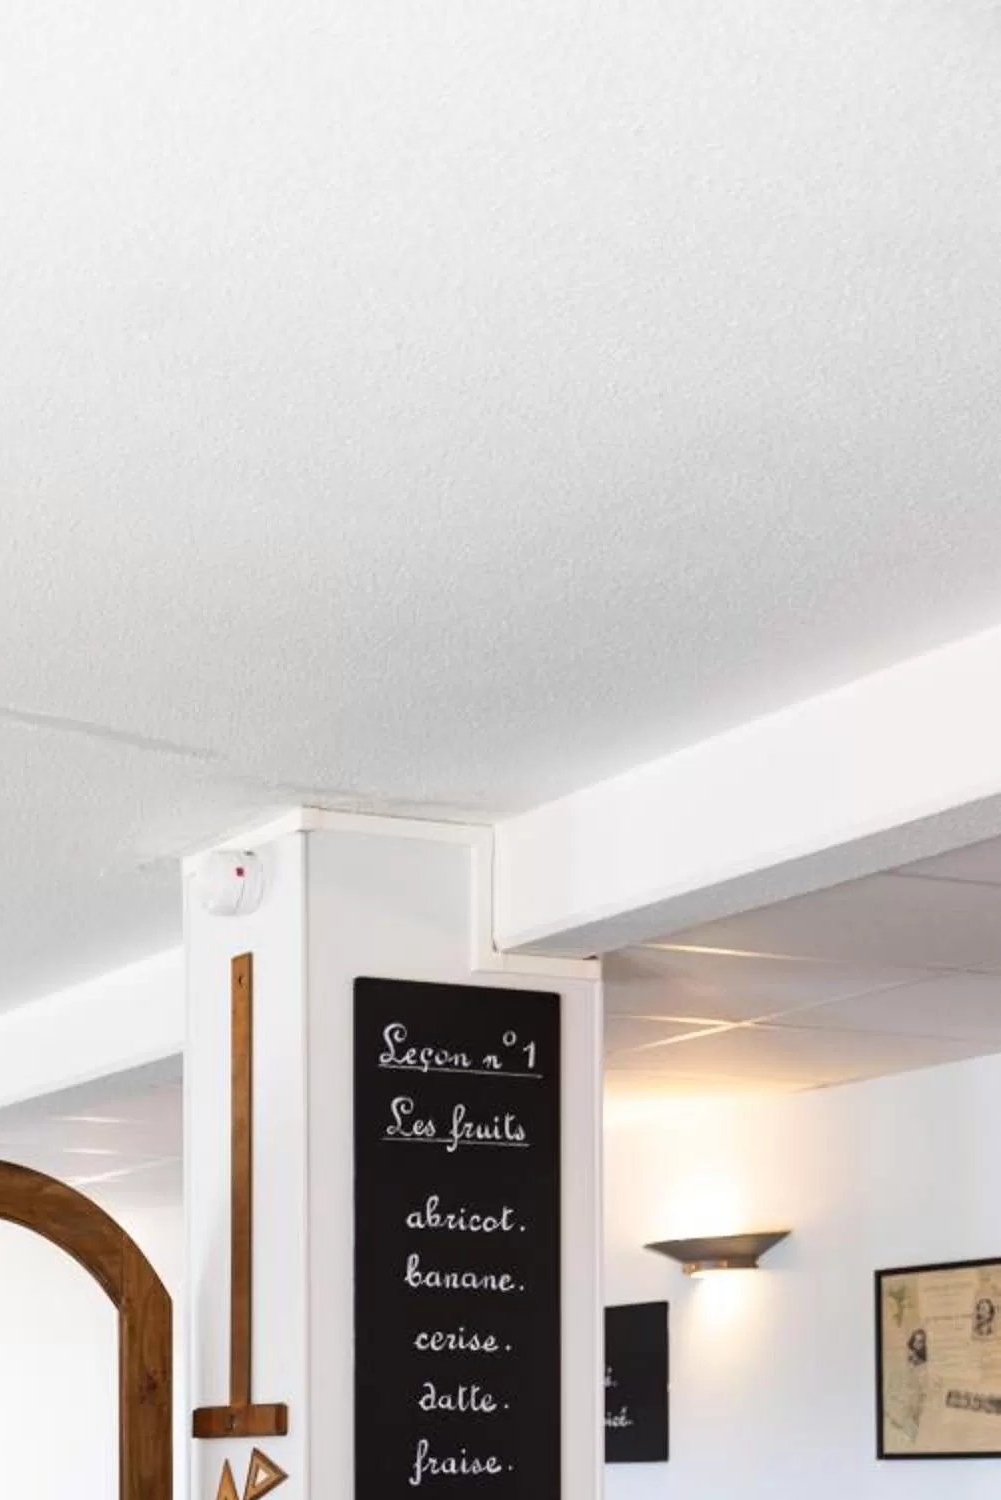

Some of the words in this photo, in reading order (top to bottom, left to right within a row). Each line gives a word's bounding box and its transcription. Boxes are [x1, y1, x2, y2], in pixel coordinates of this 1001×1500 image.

[378, 1022, 472, 1073] Leçon
[386, 1096, 436, 1137] Les
[446, 1103, 527, 1153] fruits
[405, 1194, 527, 1233] abricot.
[404, 1253, 525, 1292] banane.
[414, 1327, 512, 1352] cerise.
[418, 1381, 510, 1412] datte.
[408, 1438, 513, 1486] fraise.
